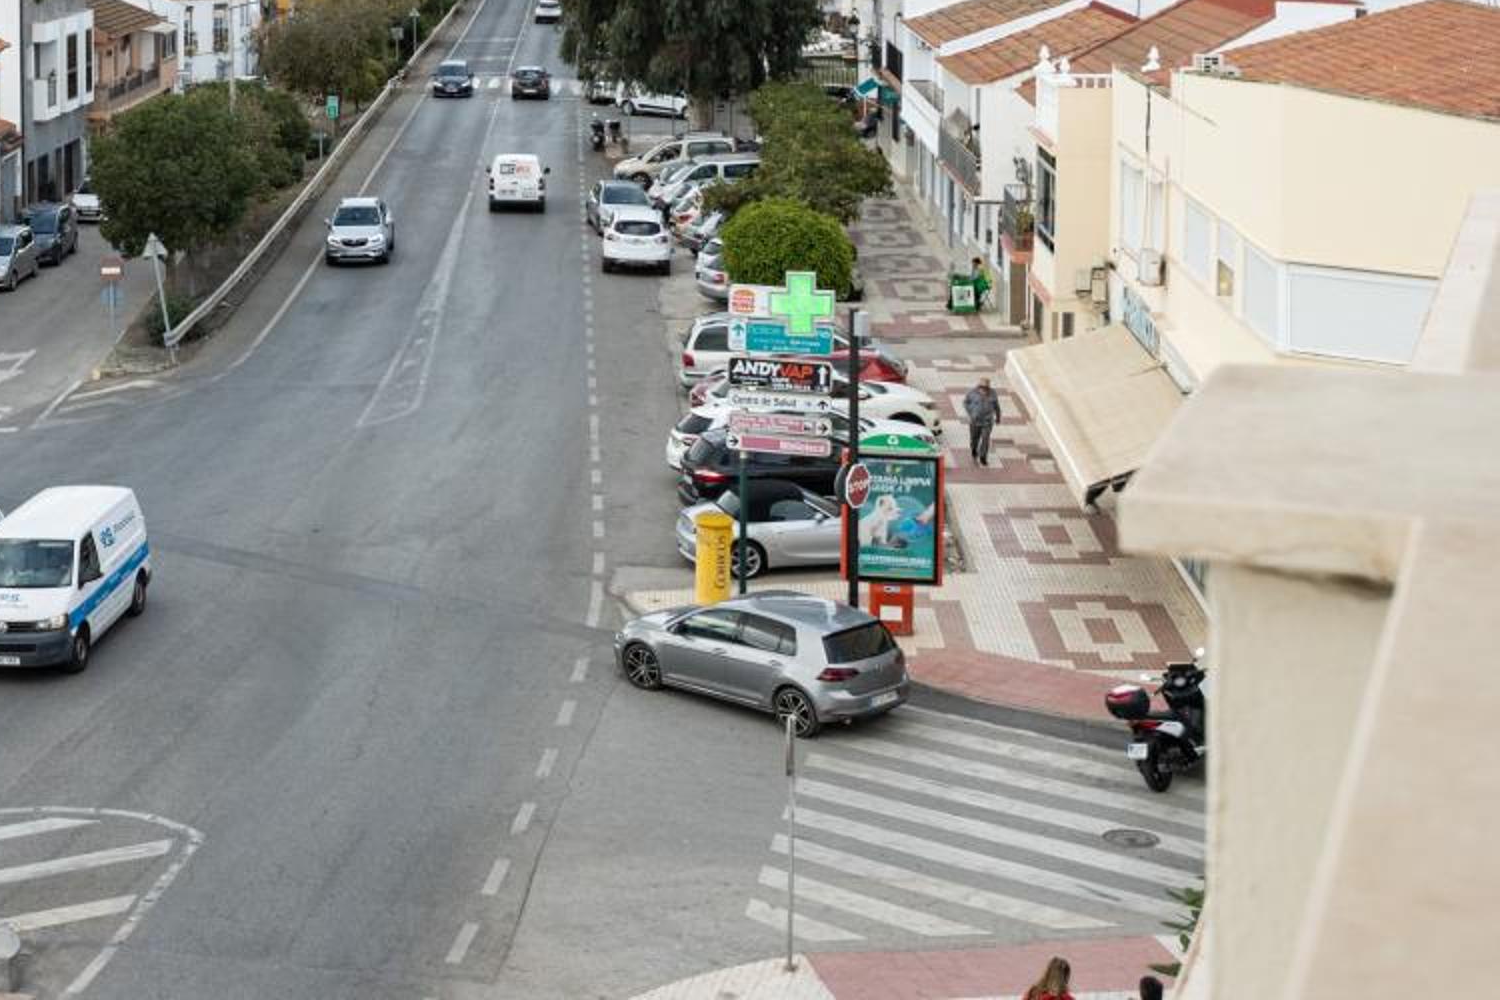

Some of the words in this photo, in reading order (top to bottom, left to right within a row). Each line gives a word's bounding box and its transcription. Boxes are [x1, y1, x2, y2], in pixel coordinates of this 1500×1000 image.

[732, 359, 813, 378] ANDYVAP
[732, 393, 759, 405] Centro
[773, 397, 797, 408] Salud
